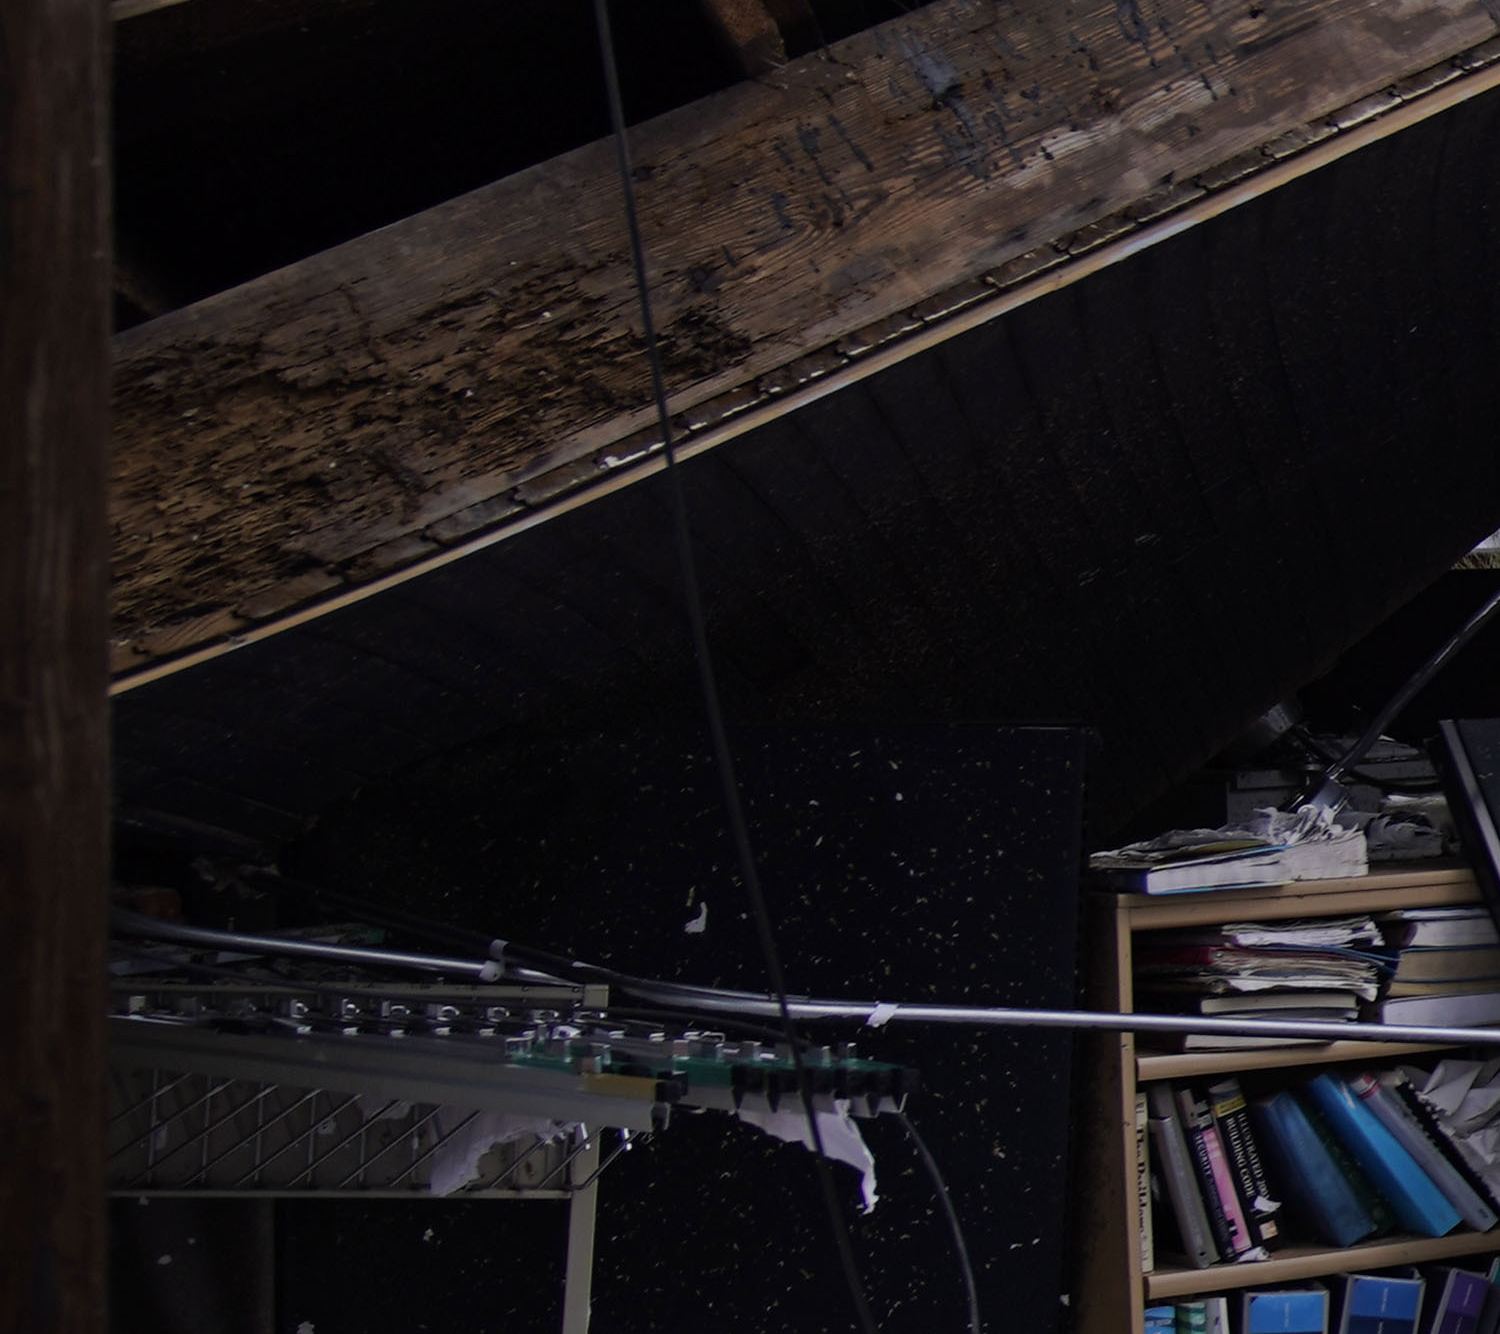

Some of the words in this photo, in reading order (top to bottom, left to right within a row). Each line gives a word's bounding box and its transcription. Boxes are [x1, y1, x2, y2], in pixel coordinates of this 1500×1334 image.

[1225, 1117, 1247, 1168] BUILDING
[1239, 1167, 1257, 1198] CODE
[1238, 1112, 1264, 1178] ILLUSTRATED
